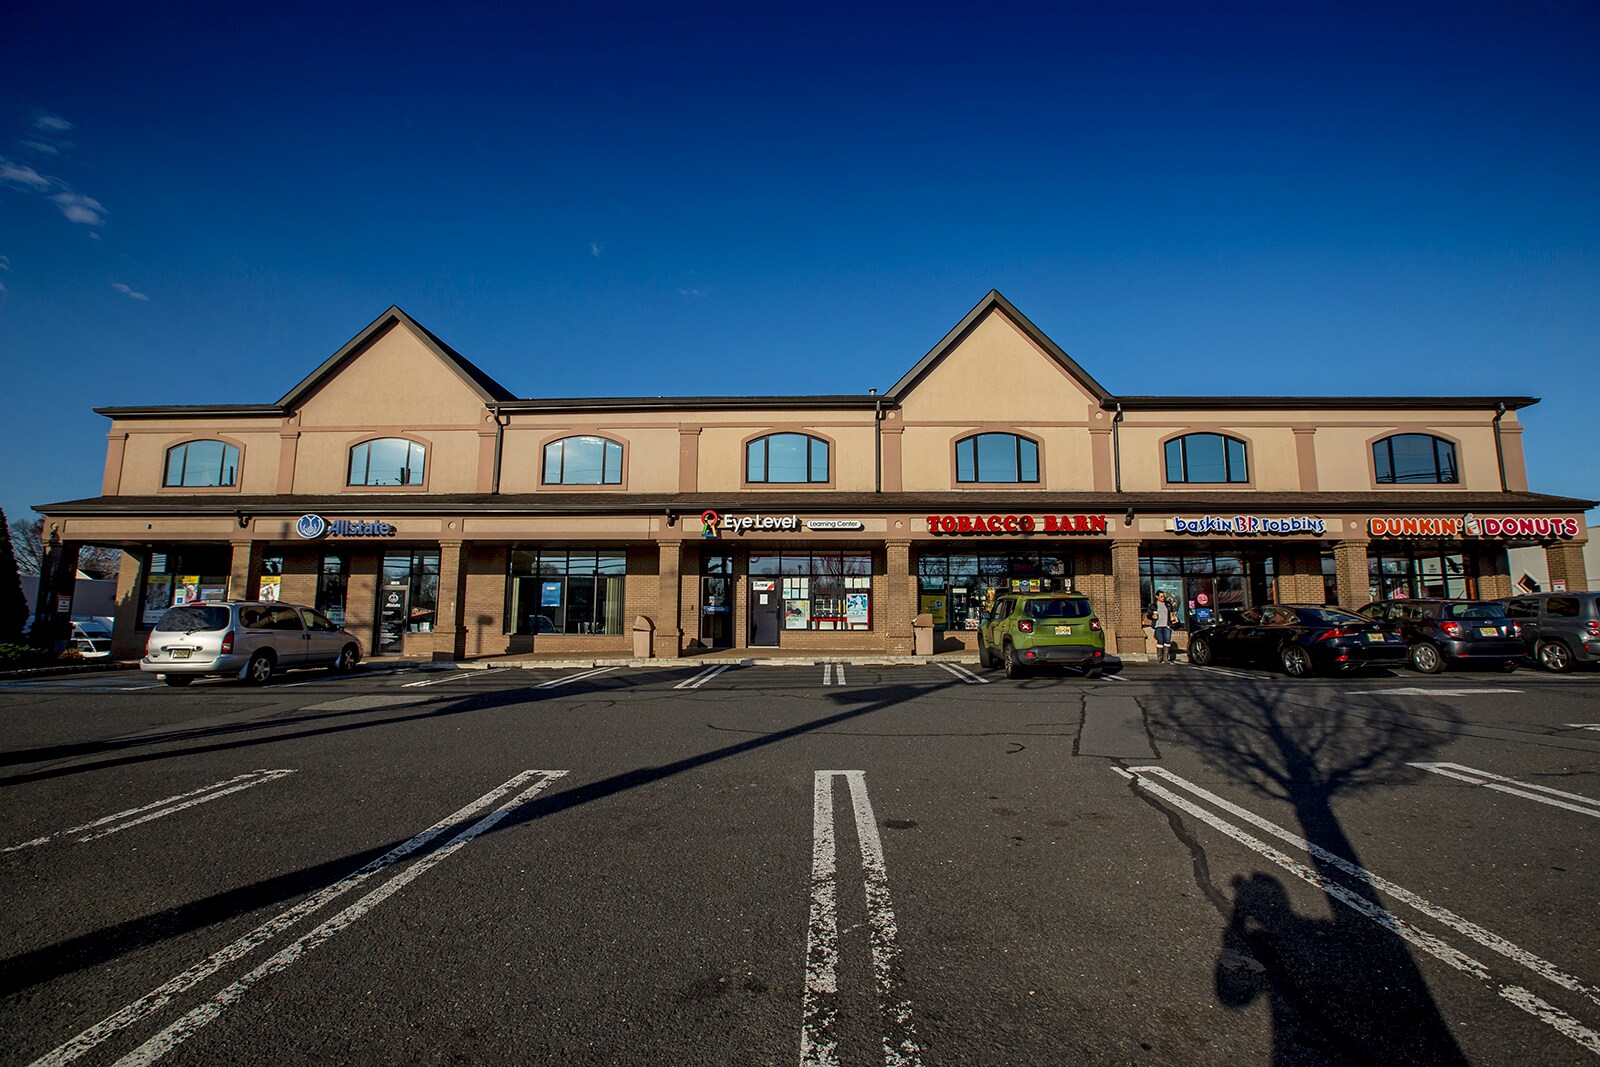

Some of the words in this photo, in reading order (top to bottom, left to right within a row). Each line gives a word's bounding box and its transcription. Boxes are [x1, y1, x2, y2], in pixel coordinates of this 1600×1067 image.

[327, 519, 390, 535] Allstate
[724, 513, 753, 532] Eye
[756, 514, 798, 528] Level
[809, 521, 836, 529] Learning
[926, 515, 1035, 533] TOBACCO
[1043, 515, 1106, 533] BARN
[1174, 514, 1232, 533] baskin
[1234, 515, 1259, 533] BR
[1261, 515, 1325, 533] robbins
[1370, 517, 1463, 535] DUNKIN'
[1484, 517, 1579, 536] DONUTS
